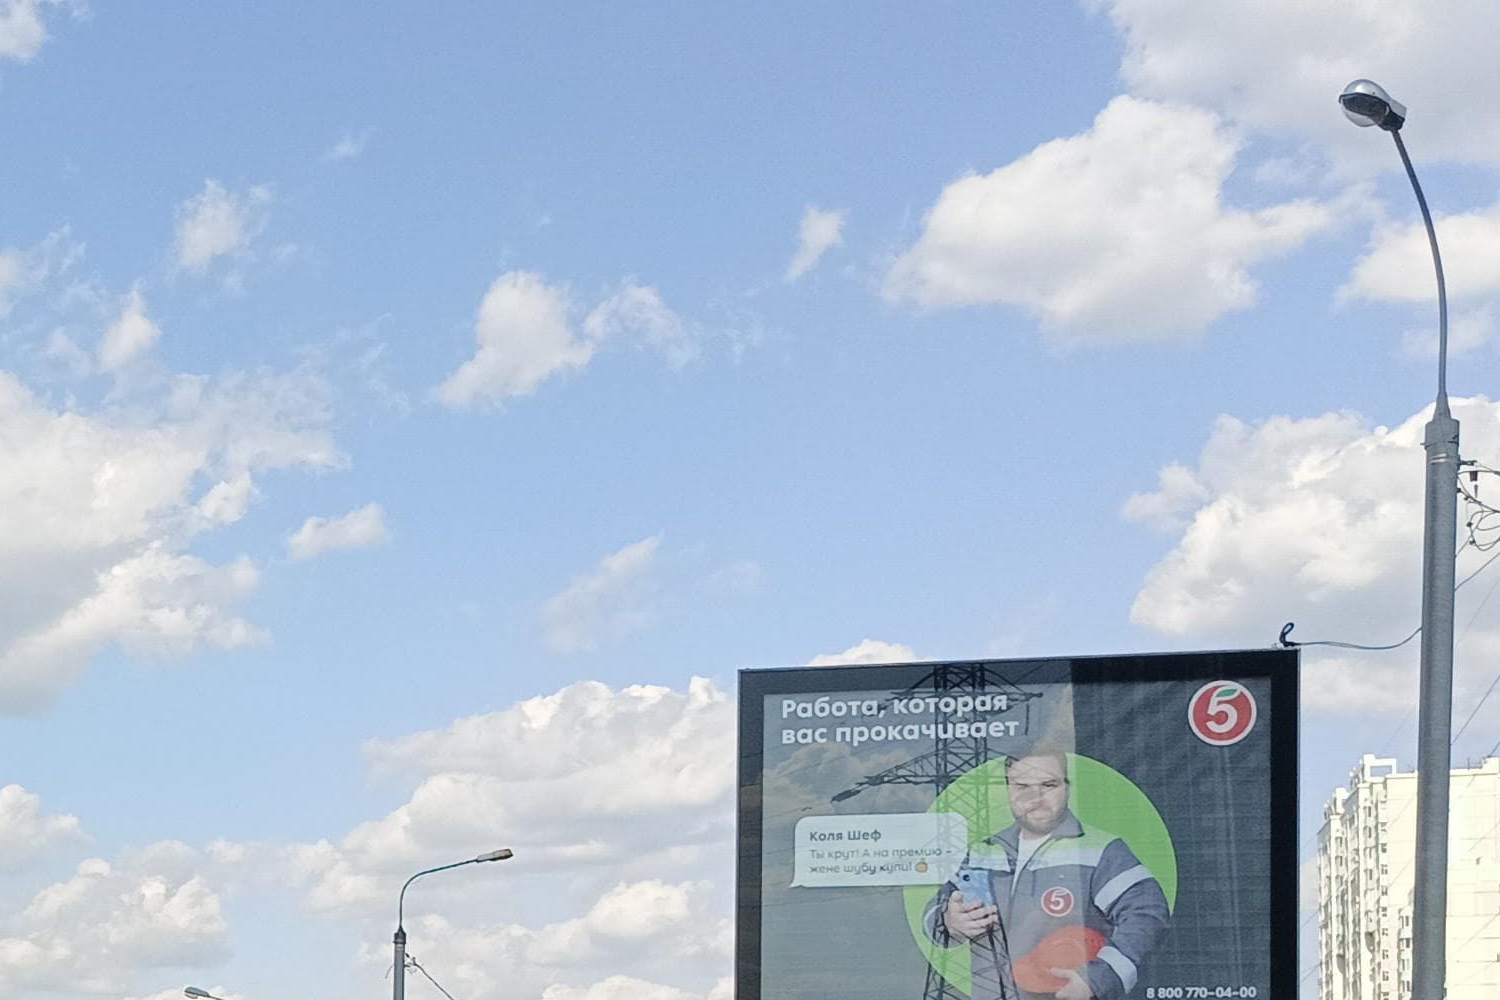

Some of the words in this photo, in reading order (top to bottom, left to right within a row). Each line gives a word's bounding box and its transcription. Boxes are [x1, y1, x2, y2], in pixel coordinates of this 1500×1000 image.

[782, 696, 885, 719] Работа,
[894, 694, 1007, 717] которая
[782, 728, 827, 744] вас
[835, 720, 1019, 746] прокачивает
[810, 832, 843, 841] Коля
[848, 830, 882, 842] Шеф
[811, 850, 825, 858] Ты
[828, 850, 860, 860] крут!
[862, 849, 870, 857] А
[892, 849, 942, 858] премию
[810, 865, 841, 874] жене
[844, 863, 876, 875] шубу
[880, 861, 912, 874] купи!
[1147, 987, 1155, 999] 8
[1158, 987, 1183, 999] 800
